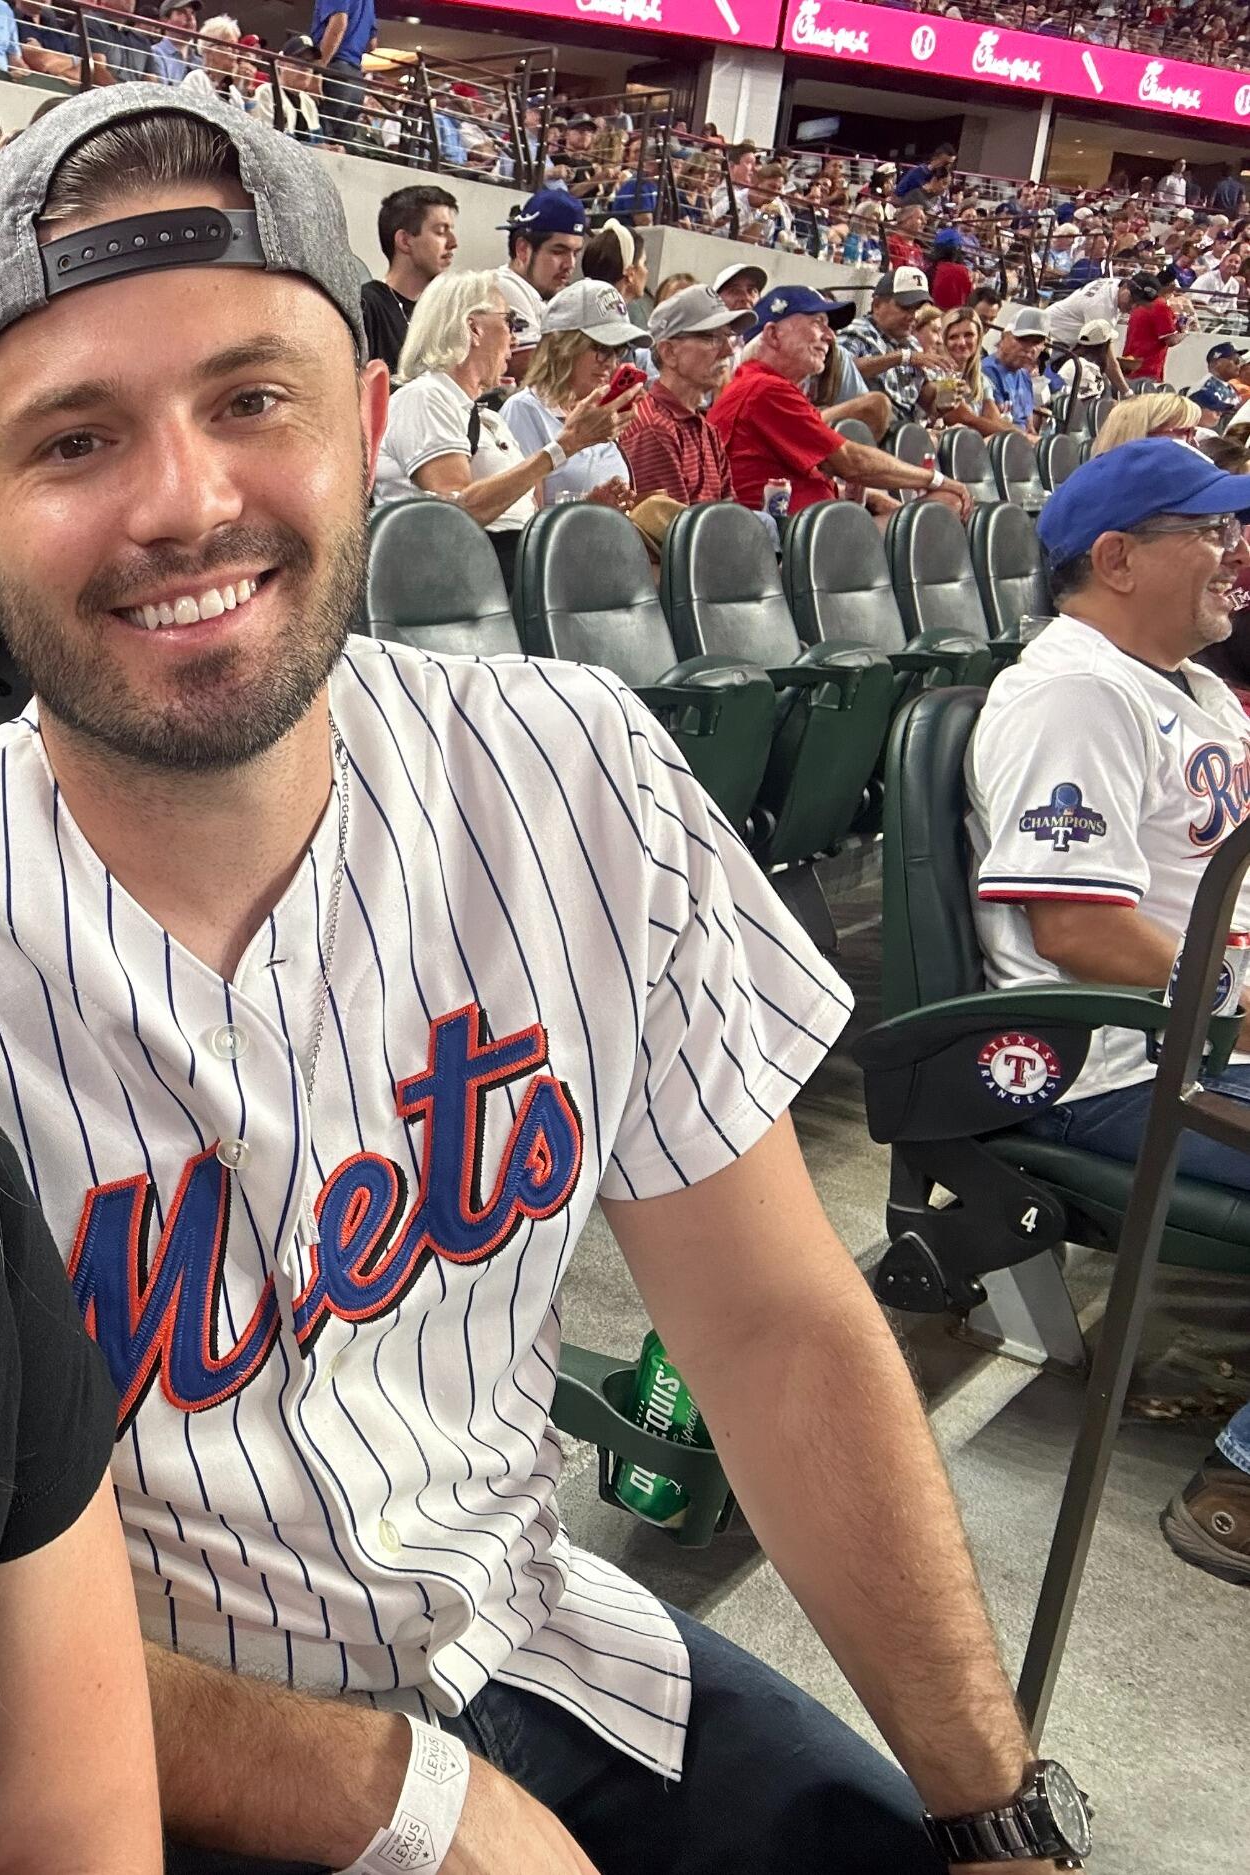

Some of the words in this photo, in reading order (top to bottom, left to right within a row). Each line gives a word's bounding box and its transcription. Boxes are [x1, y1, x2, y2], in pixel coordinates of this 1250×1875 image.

[1020, 816, 1106, 835] CHAMPIONS
[1051, 826, 1073, 848] T
[989, 1035, 1053, 1060] TEXAS
[1004, 1054, 1036, 1088] T
[981, 1069, 1056, 1104] RANGERS
[68, 1002, 584, 1442] Mets
[1020, 1206, 1038, 1232] 4
[426, 1738, 440, 1777] LEXUS
[391, 1822, 421, 1864] LEXUS
[409, 1838, 425, 1861] CLUB
